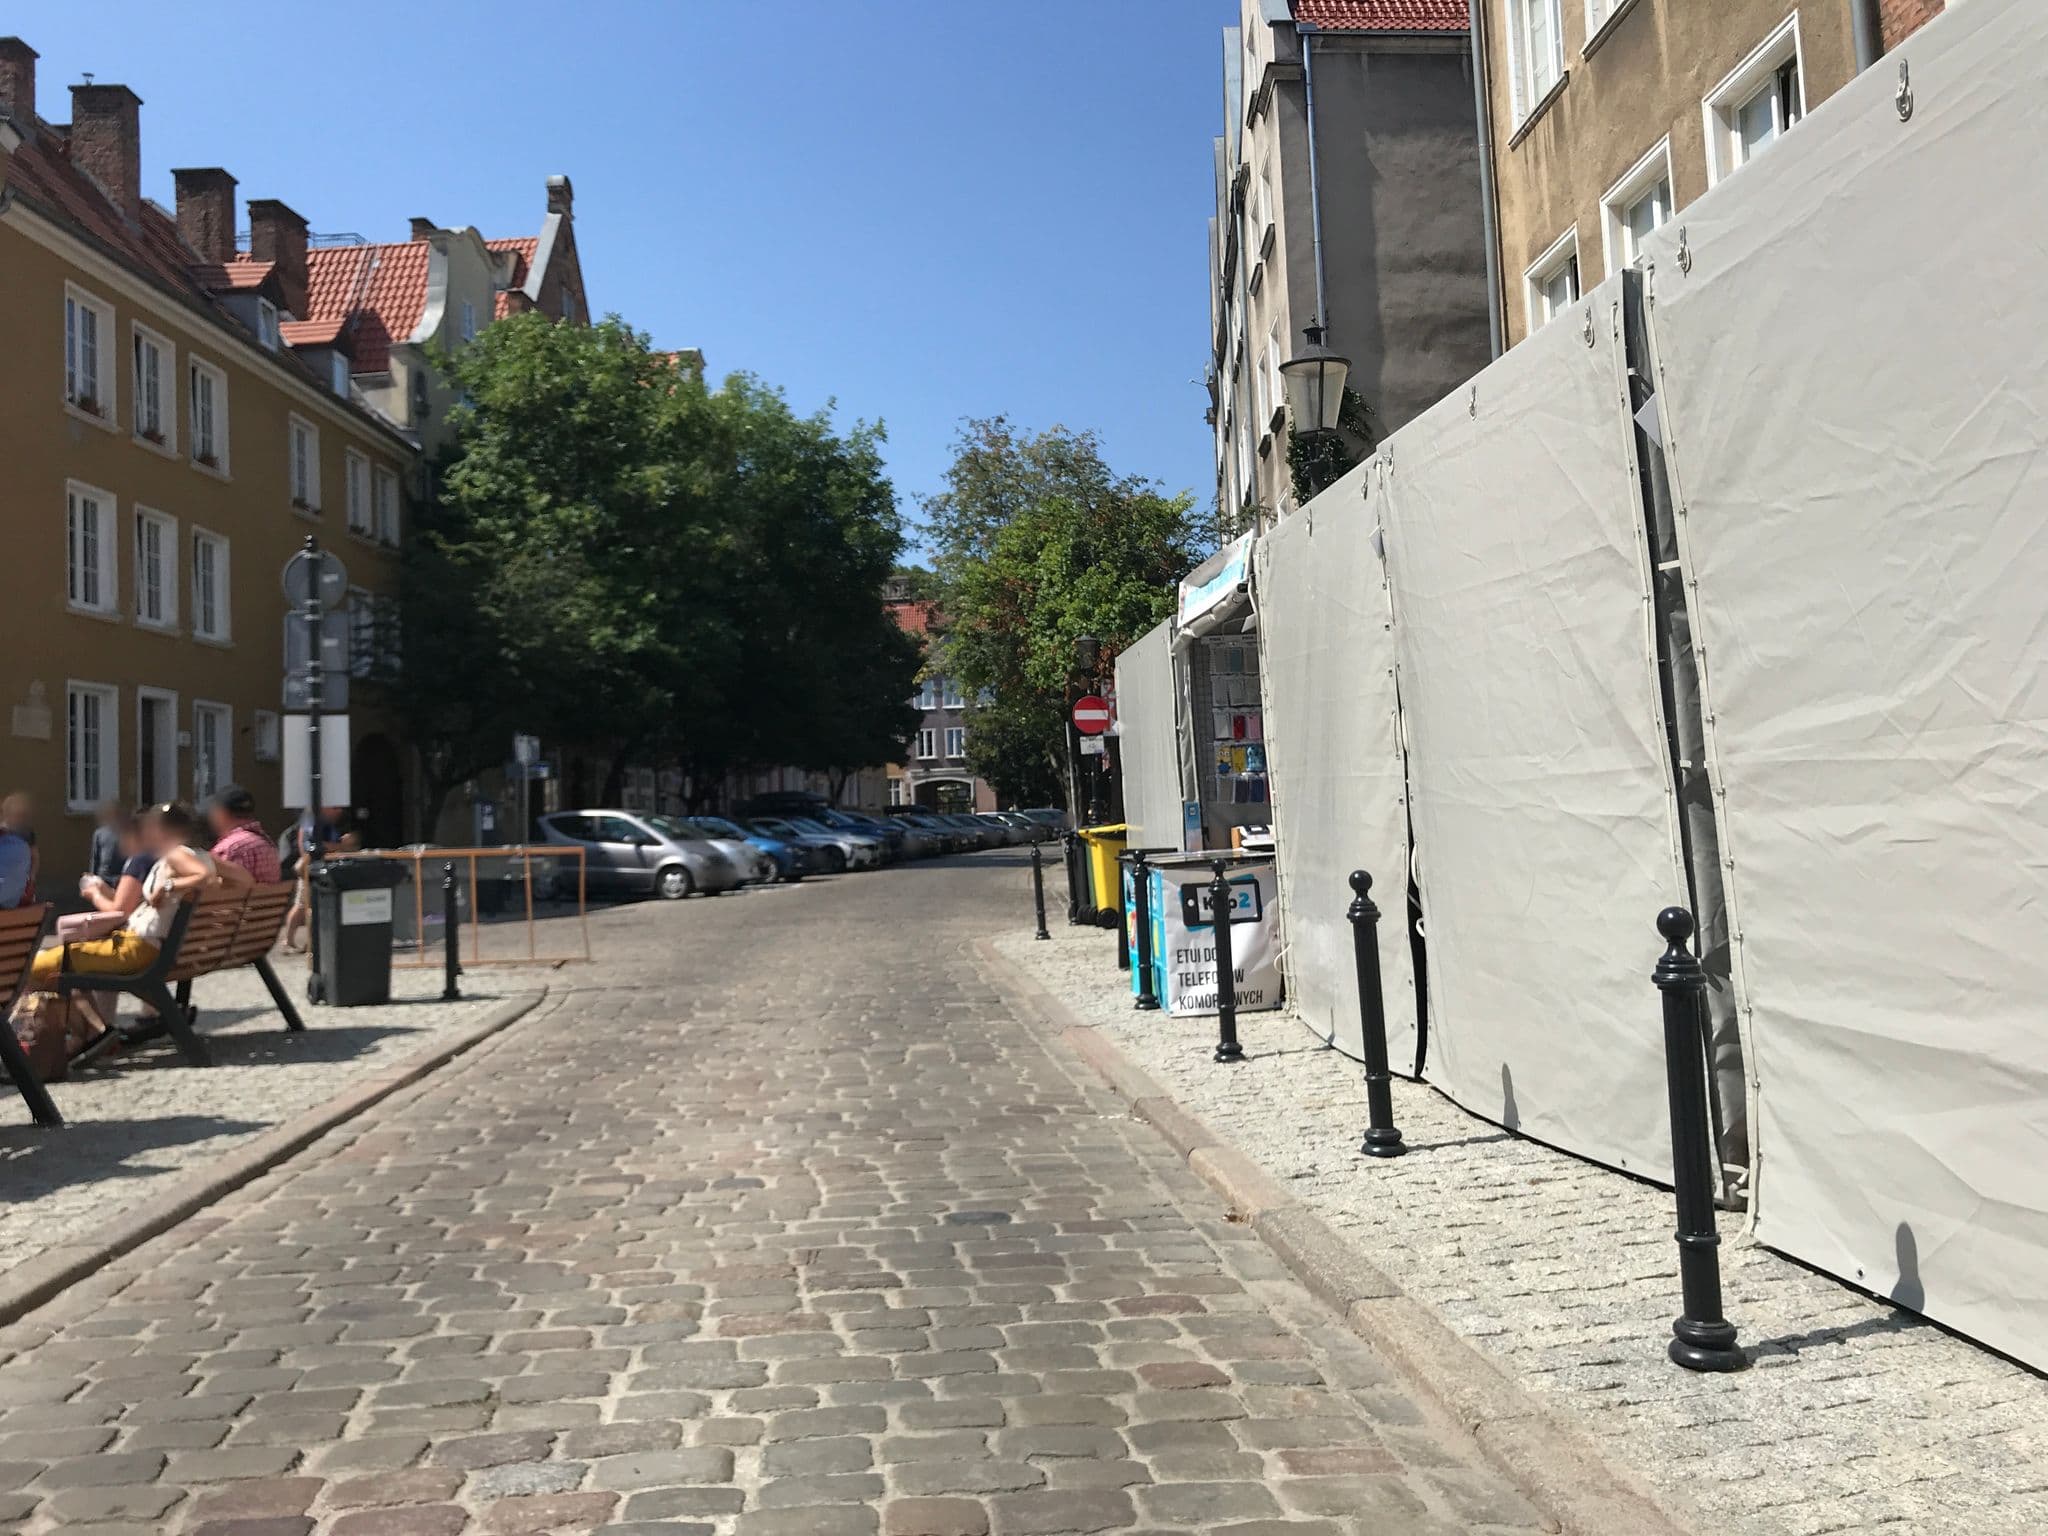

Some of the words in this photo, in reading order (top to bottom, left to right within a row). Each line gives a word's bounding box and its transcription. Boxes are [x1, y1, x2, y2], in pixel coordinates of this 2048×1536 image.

[1203, 891, 1250, 912] Kp2
[1177, 949, 1201, 964] ETUI
[1204, 948, 1217, 961] DO
[1178, 968, 1244, 987] TELEFOW
[1179, 990, 1263, 1010] KOMORWYCH
